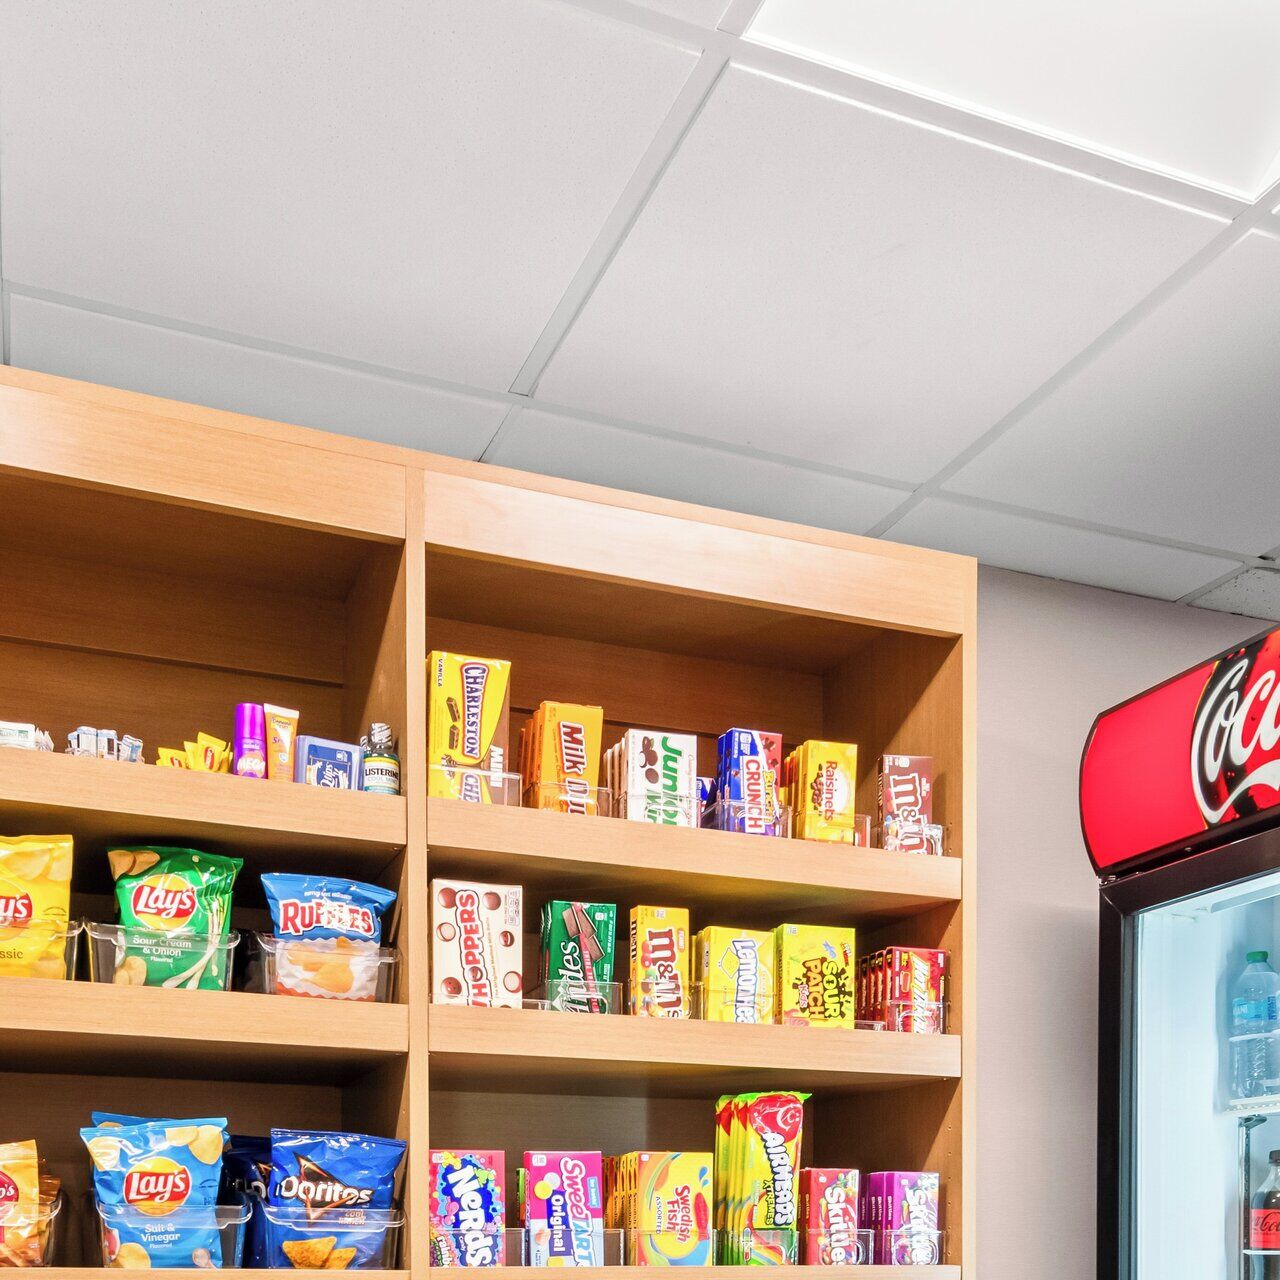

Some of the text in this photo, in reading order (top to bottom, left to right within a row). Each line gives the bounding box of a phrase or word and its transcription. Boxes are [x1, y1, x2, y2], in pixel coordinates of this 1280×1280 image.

[465, 666, 486, 757] CHARLESTON
[562, 722, 585, 774] Milk
[365, 768, 399, 778] LISTERINE
[745, 759, 762, 828] CRUNCH
[824, 760, 837, 821] Raisinets
[136, 884, 195, 918] Lay's
[133, 935, 192, 948] Sour Cream
[152, 948, 182, 957] Onion
[798, 984, 809, 1008] Kids
[803, 958, 825, 1018] PATCH
[823, 960, 840, 1019] SOUR
[128, 1171, 186, 1204] Lay's
[282, 1176, 373, 1205] Doritos
[145, 1224, 175, 1234] Salt &
[550, 1194, 565, 1252] Original
[675, 1184, 691, 1243] Swedish
[140, 1232, 180, 1242] Vinegar
